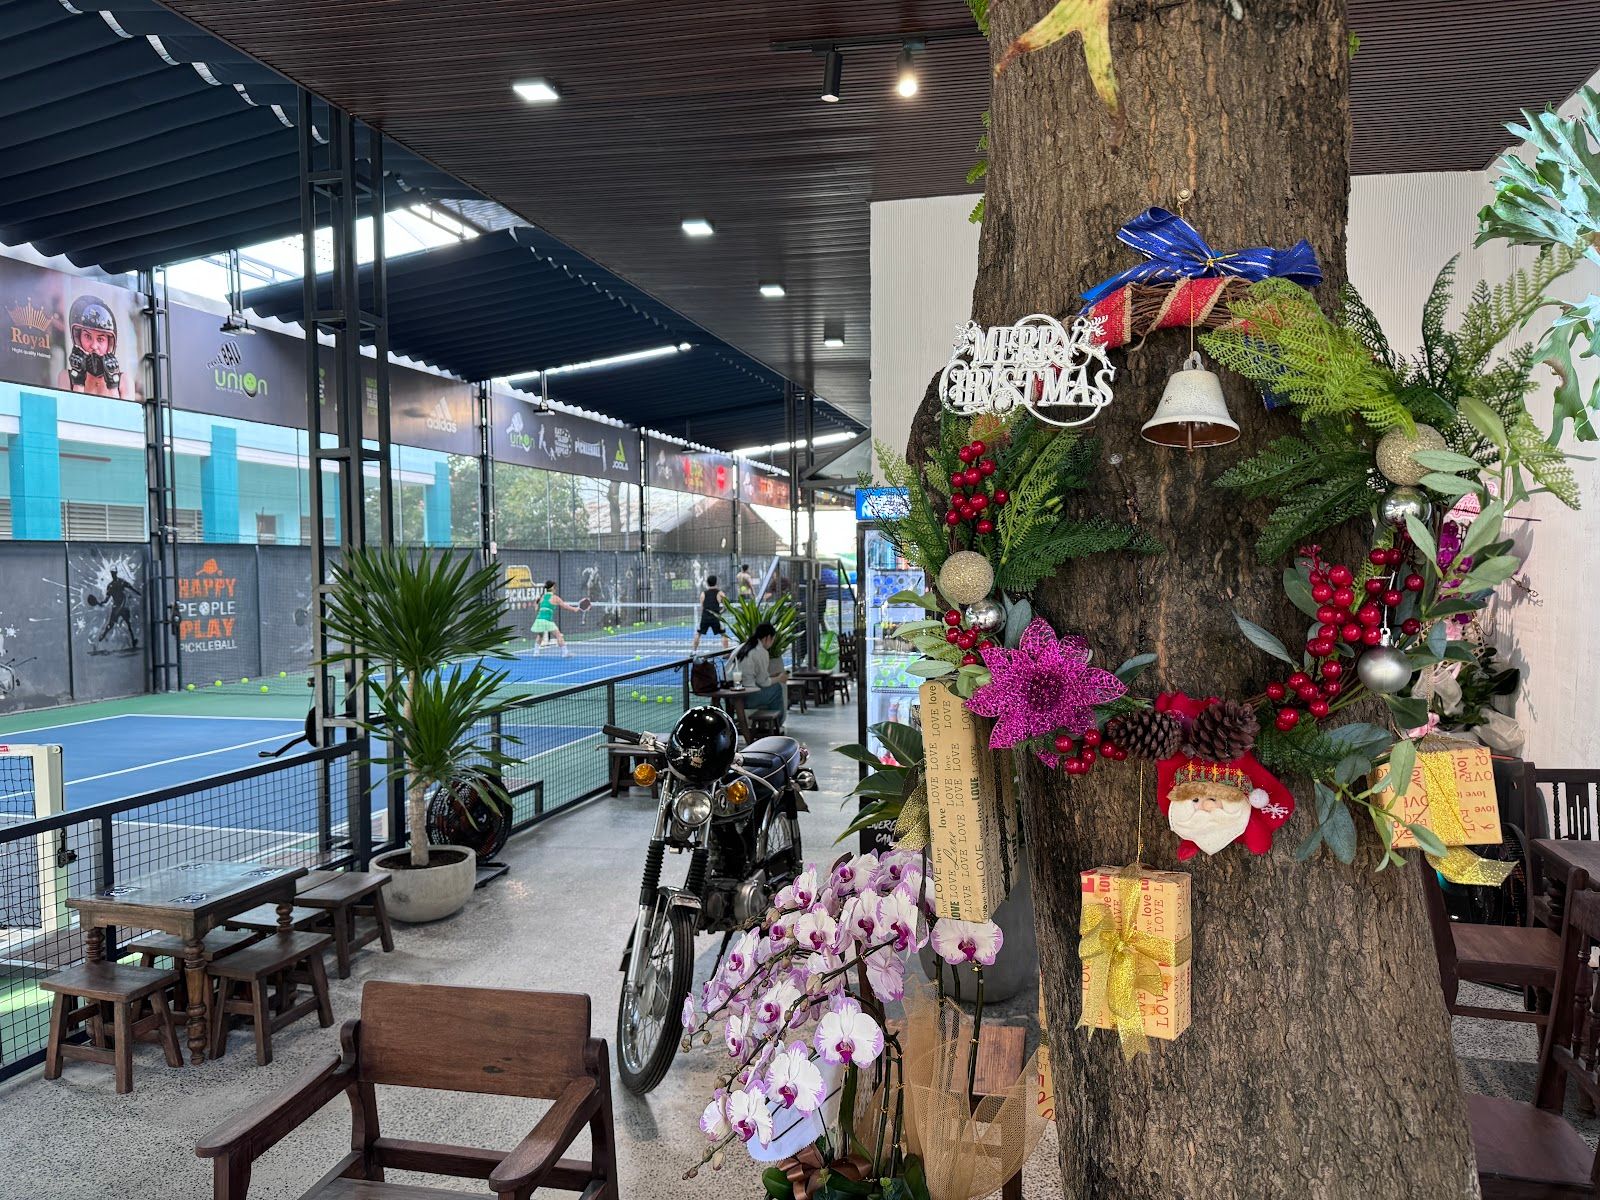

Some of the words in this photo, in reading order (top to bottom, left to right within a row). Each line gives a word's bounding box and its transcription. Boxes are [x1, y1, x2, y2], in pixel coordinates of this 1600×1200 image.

[11, 327, 51, 350] Royal
[967, 324, 1086, 368] MERRY
[214, 369, 268, 397] union
[938, 360, 1115, 416] CHRISTMAS
[426, 417, 458, 433] adidas
[179, 578, 236, 599] HAPPY
[178, 600, 236, 617] PEOPLE
[180, 617, 235, 640] PLAY
[180, 639, 238, 653] PICKLEBALL
[928, 685, 937, 705] love
[930, 708, 941, 737] LOVE
[942, 700, 952, 729] LOVE
[929, 742, 939, 771] LOVE
[951, 743, 962, 771] LOVE
[930, 776, 940, 805] LOVE
[969, 776, 980, 800] LOVE
[1465, 770, 1493, 784] OVE
[945, 778, 954, 806] LOVE
[953, 778, 965, 808] LOVE
[938, 808, 947, 829] love
[1474, 805, 1496, 814] love
[957, 814, 967, 844] LOVE
[960, 848, 969, 878] LOVE
[974, 843, 985, 877] LOVE
[947, 869, 958, 899] LOVE
[962, 885, 973, 914] LOVE
[1143, 894, 1151, 917] love
[1114, 899, 1124, 932] LOVE
[1154, 899, 1164, 933] LOVE
